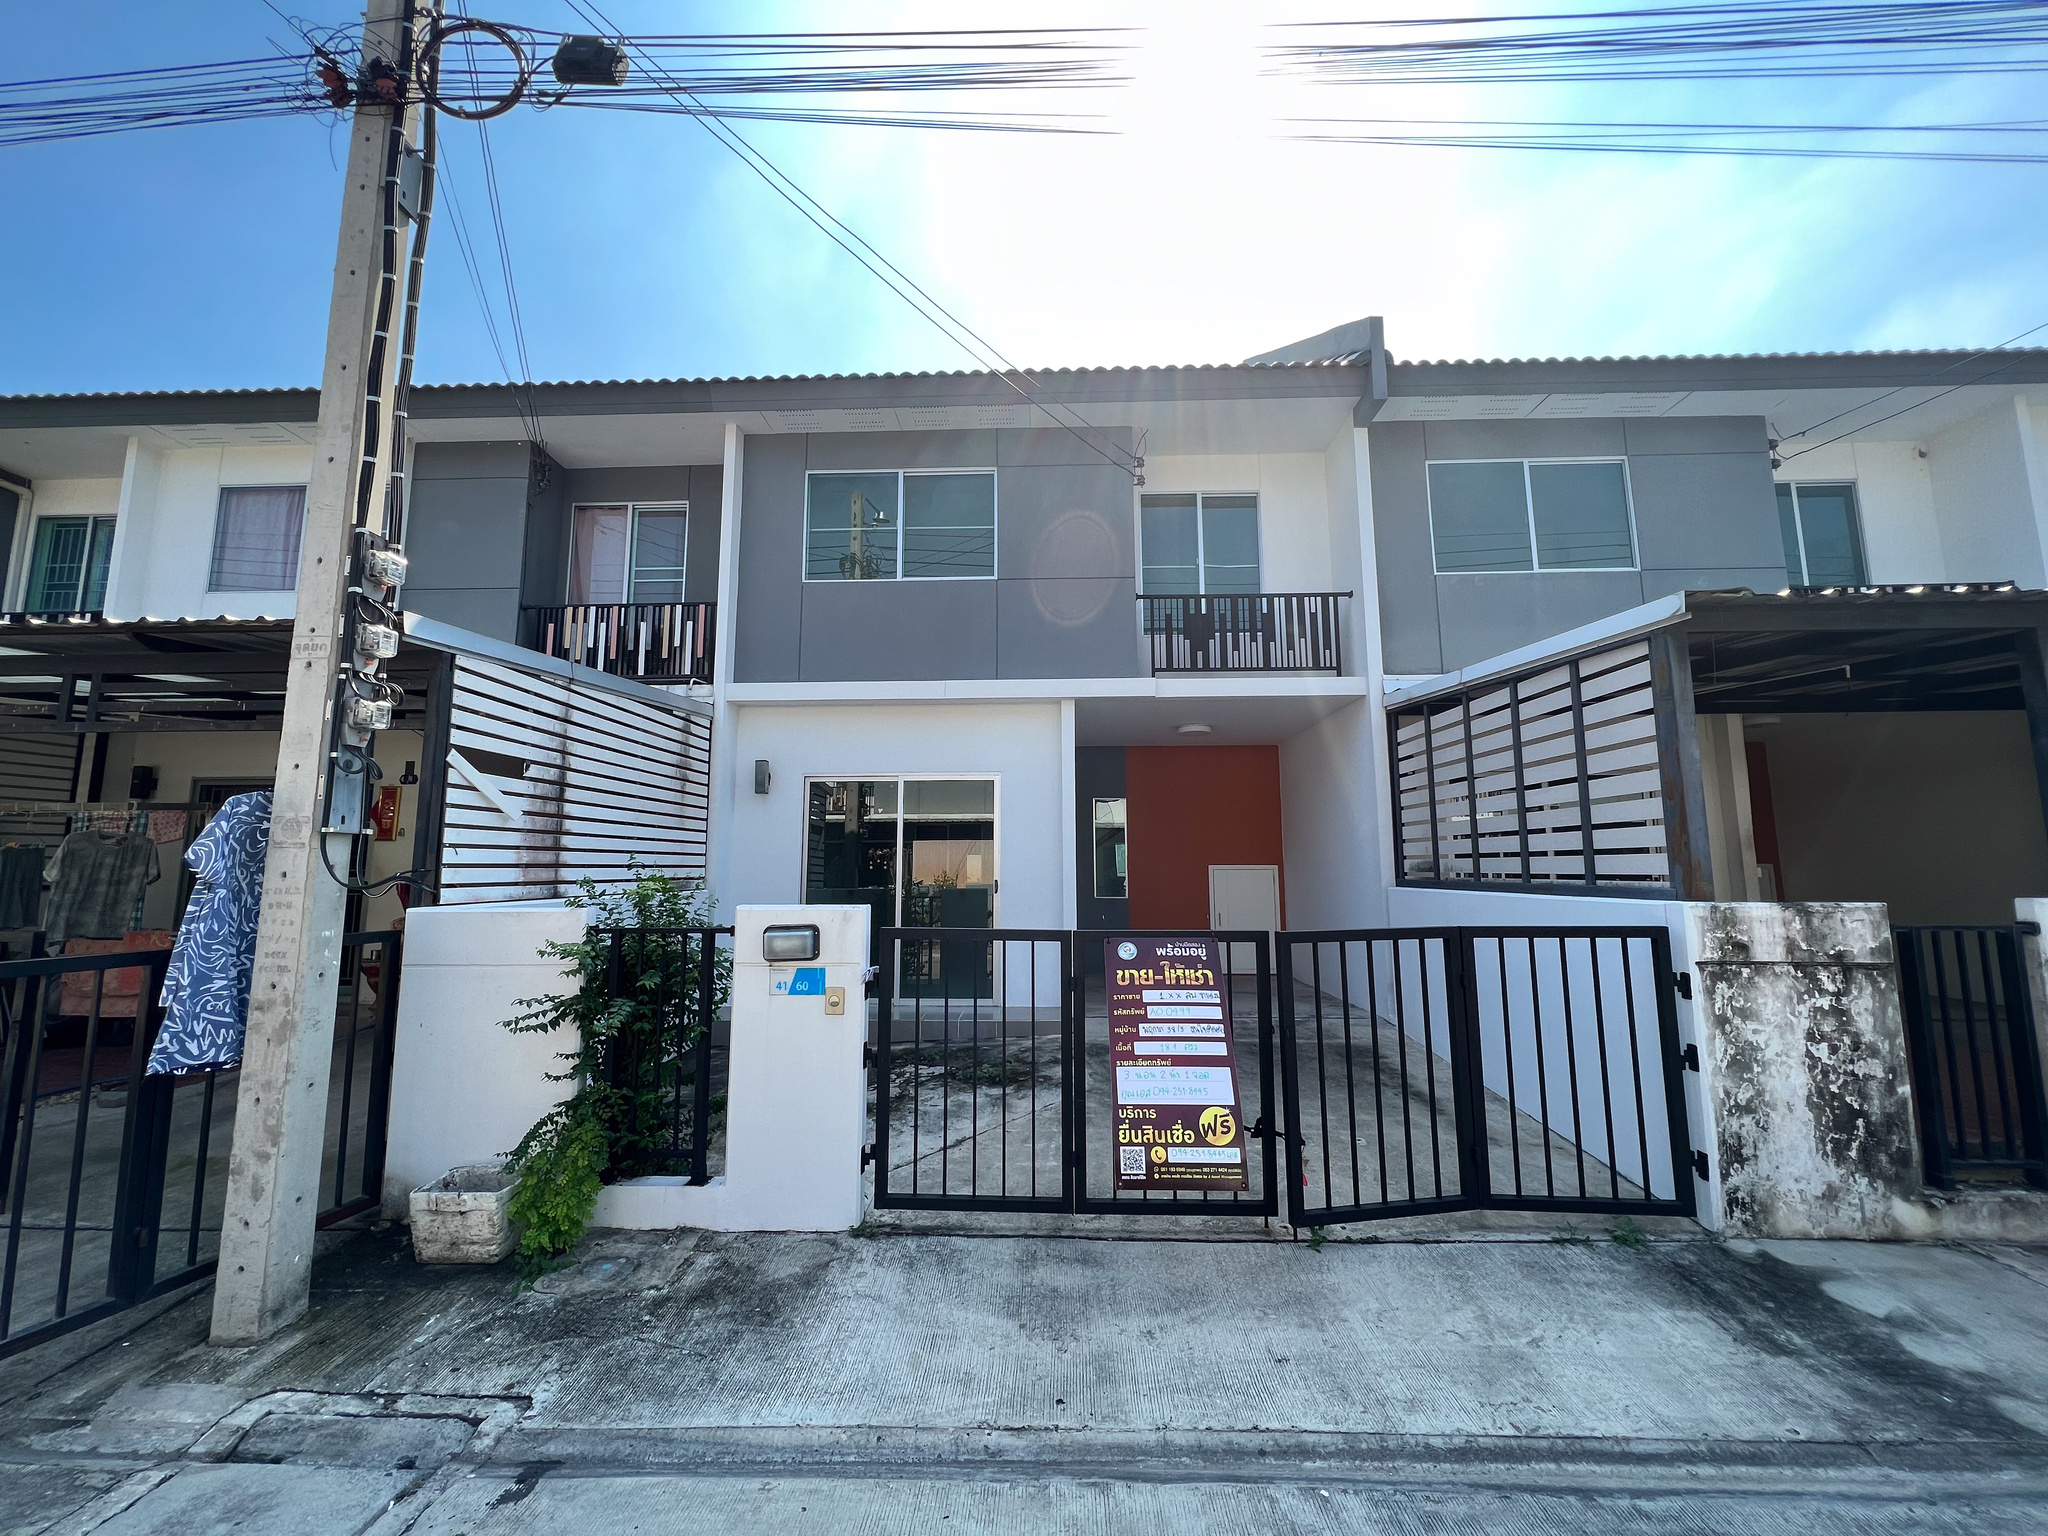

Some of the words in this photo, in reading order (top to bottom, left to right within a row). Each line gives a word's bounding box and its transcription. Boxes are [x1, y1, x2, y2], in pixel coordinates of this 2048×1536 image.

[1156, 943, 1207, 960] พร้อมอยู่
[1116, 961, 1215, 986] ขาย-ให้เช่า
[776, 981, 788, 991] 41
[795, 980, 809, 991] 60
[1118, 1105, 1157, 1119] บริการ
[1118, 1119, 1196, 1144] ยื่นสินเชื่อ
[1201, 1112, 1232, 1139] ฟรี
